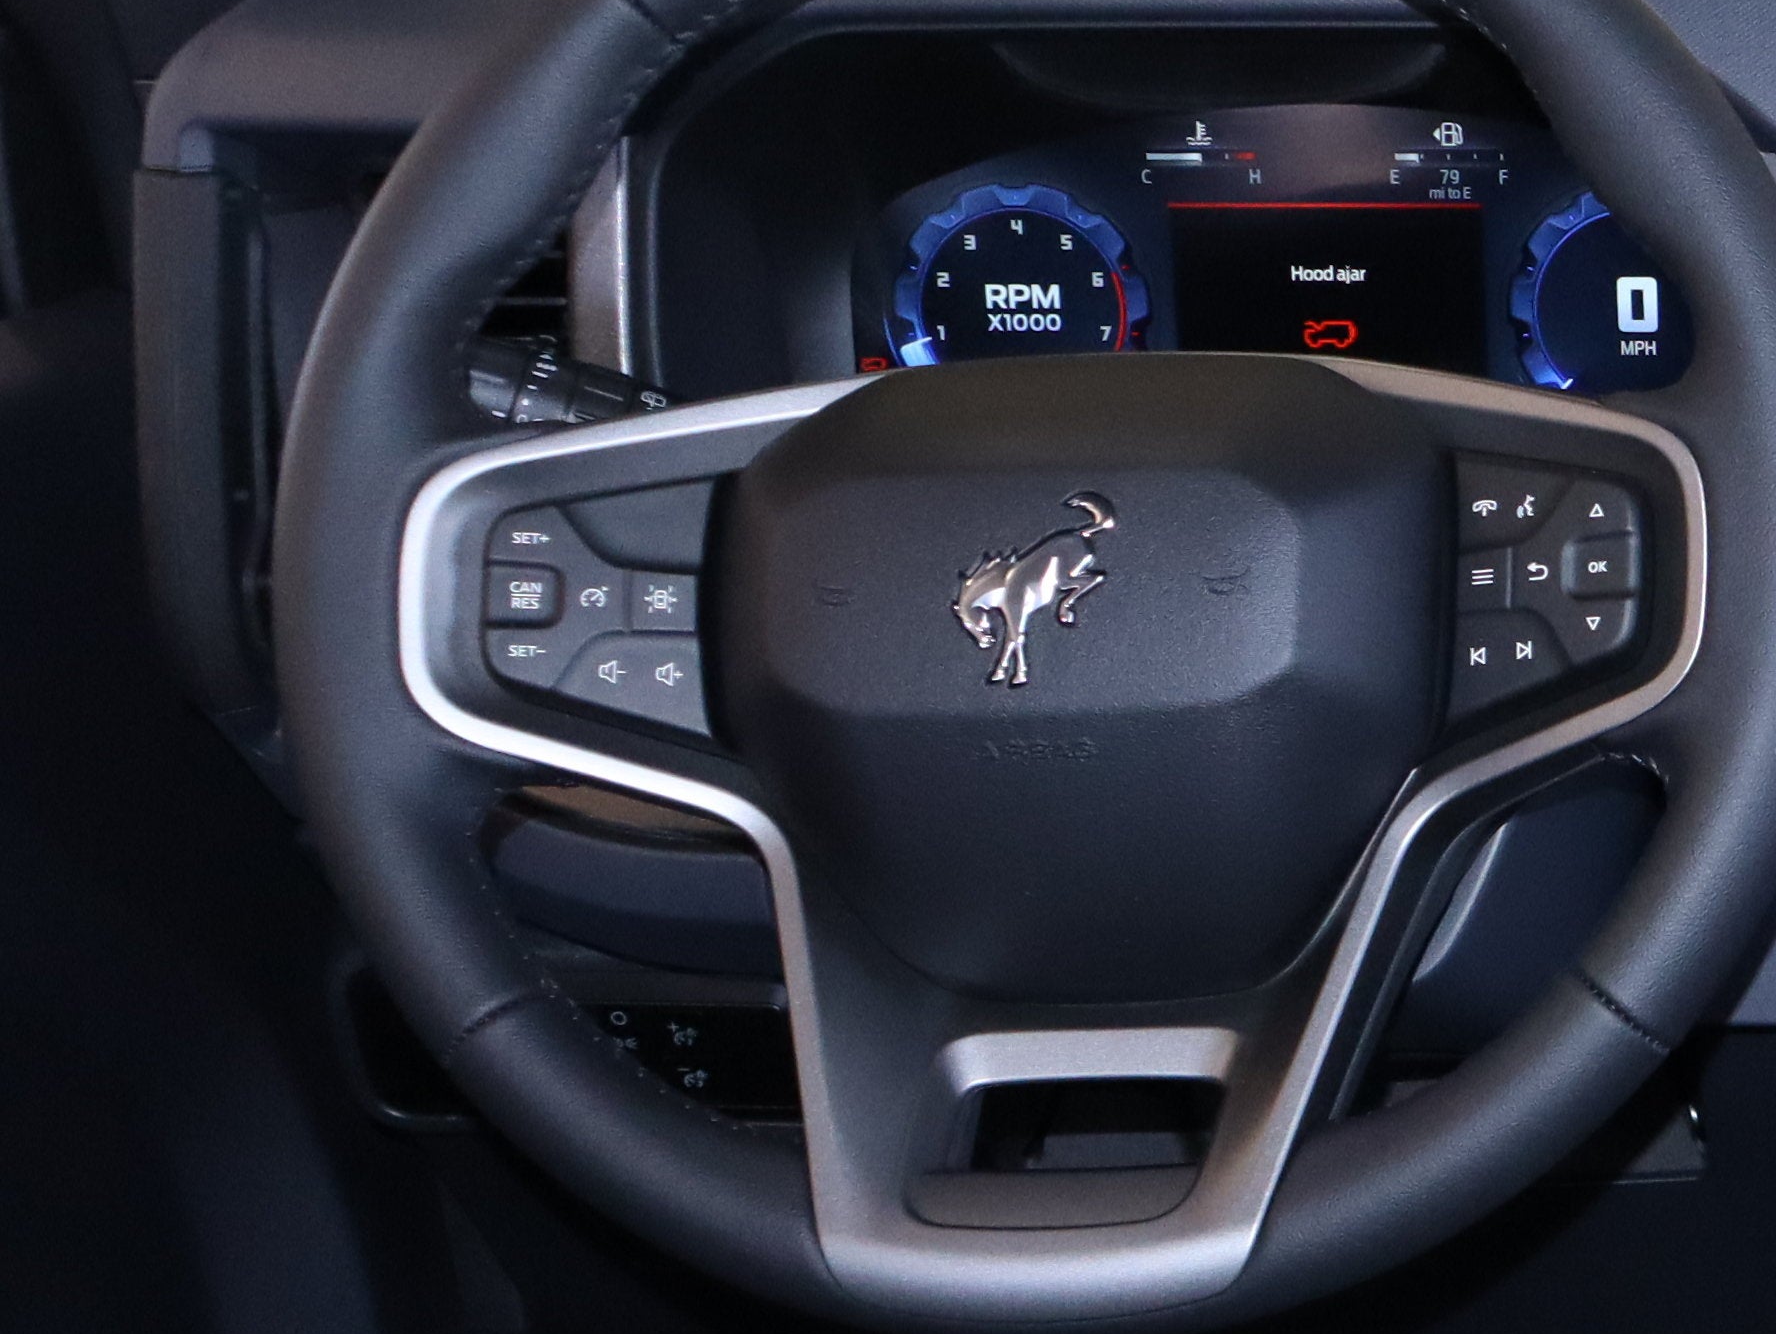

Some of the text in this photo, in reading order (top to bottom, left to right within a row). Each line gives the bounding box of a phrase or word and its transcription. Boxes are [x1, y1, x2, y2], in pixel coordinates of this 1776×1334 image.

[1141, 170, 1152, 184] C
[1249, 170, 1261, 184] H
[1390, 170, 1400, 184] E
[1440, 170, 1460, 185] 79
[1499, 170, 1508, 184] F
[1429, 188, 1471, 200] mi to E
[1010, 219, 1024, 235] 4
[963, 235, 977, 250] 3
[1060, 235, 1073, 250] 5
[936, 272, 950, 288] 2
[1092, 272, 1105, 288] 6
[1291, 265, 1367, 285] Hood ajar
[984, 284, 1062, 310] RPM
[1616, 275, 1660, 333] 0
[988, 313, 1062, 332] X1000
[937, 325, 946, 341] 1
[1100, 325, 1112, 342] 7
[1620, 340, 1658, 357] MPH
[1588, 560, 1609, 573] OK
[509, 581, 542, 593] CAN
[510, 598, 540, 610] RES
